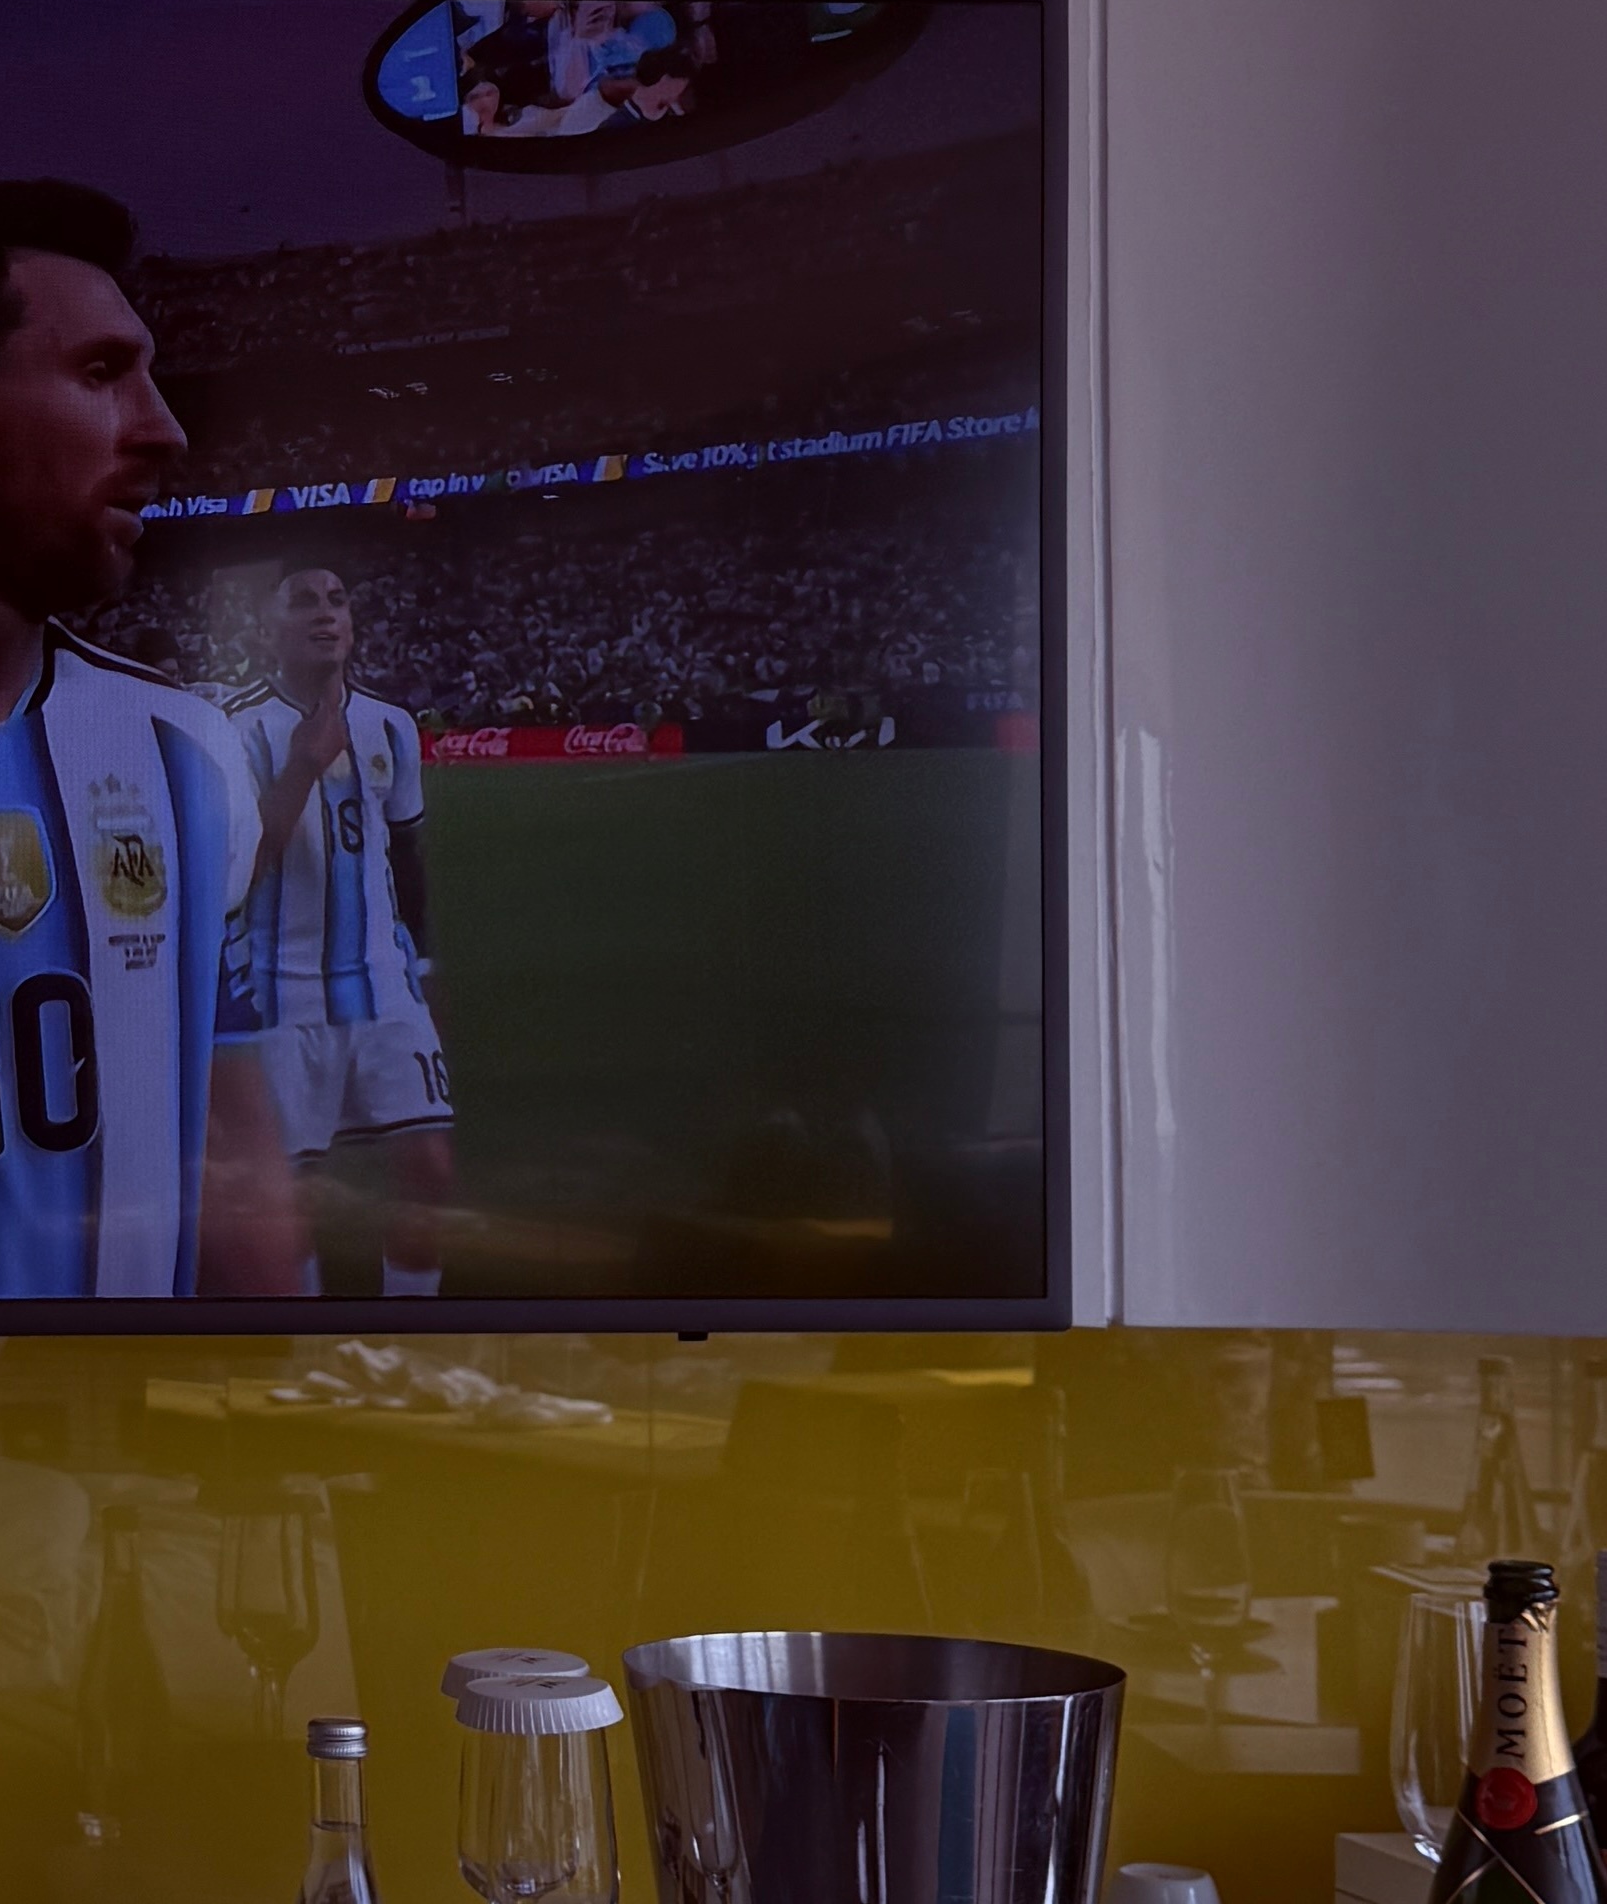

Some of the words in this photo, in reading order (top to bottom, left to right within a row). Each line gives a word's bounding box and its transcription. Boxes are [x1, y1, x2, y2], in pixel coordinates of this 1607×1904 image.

[886, 420, 942, 446] FIFA
[946, 412, 1022, 440] Store
[287, 482, 351, 509] VISA
